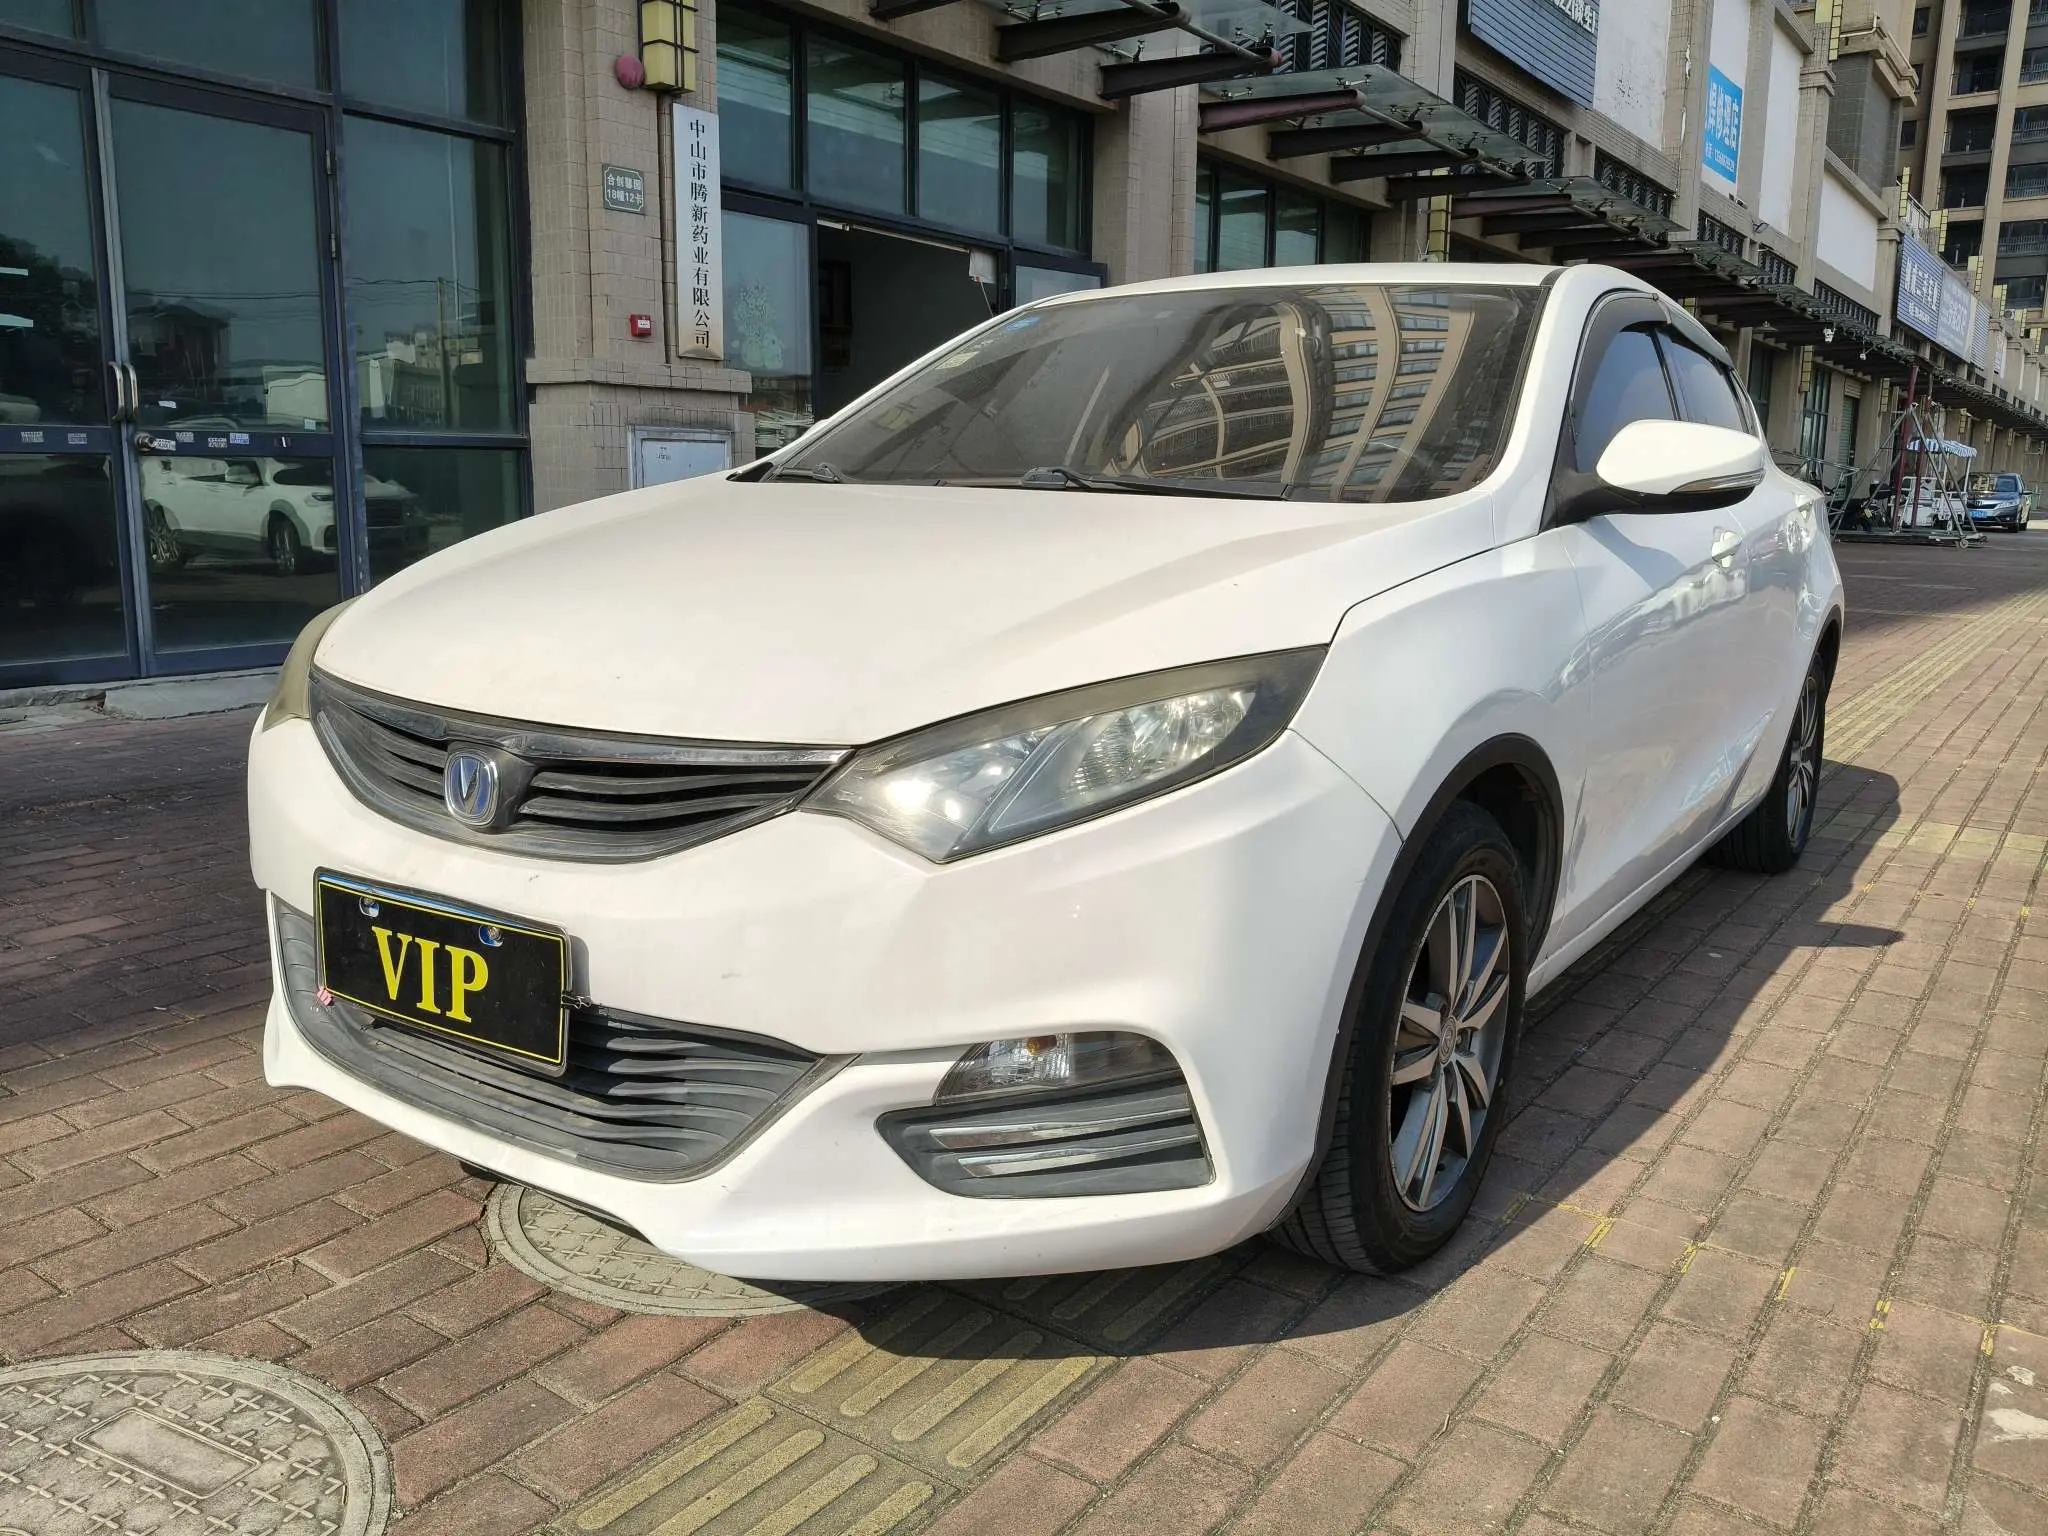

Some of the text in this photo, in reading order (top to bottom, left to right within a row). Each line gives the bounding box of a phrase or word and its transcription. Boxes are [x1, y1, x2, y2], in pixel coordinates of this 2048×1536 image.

[690, 119, 710, 350] 中山市腾新药业有限公司
[372, 926, 489, 1023] VIP
